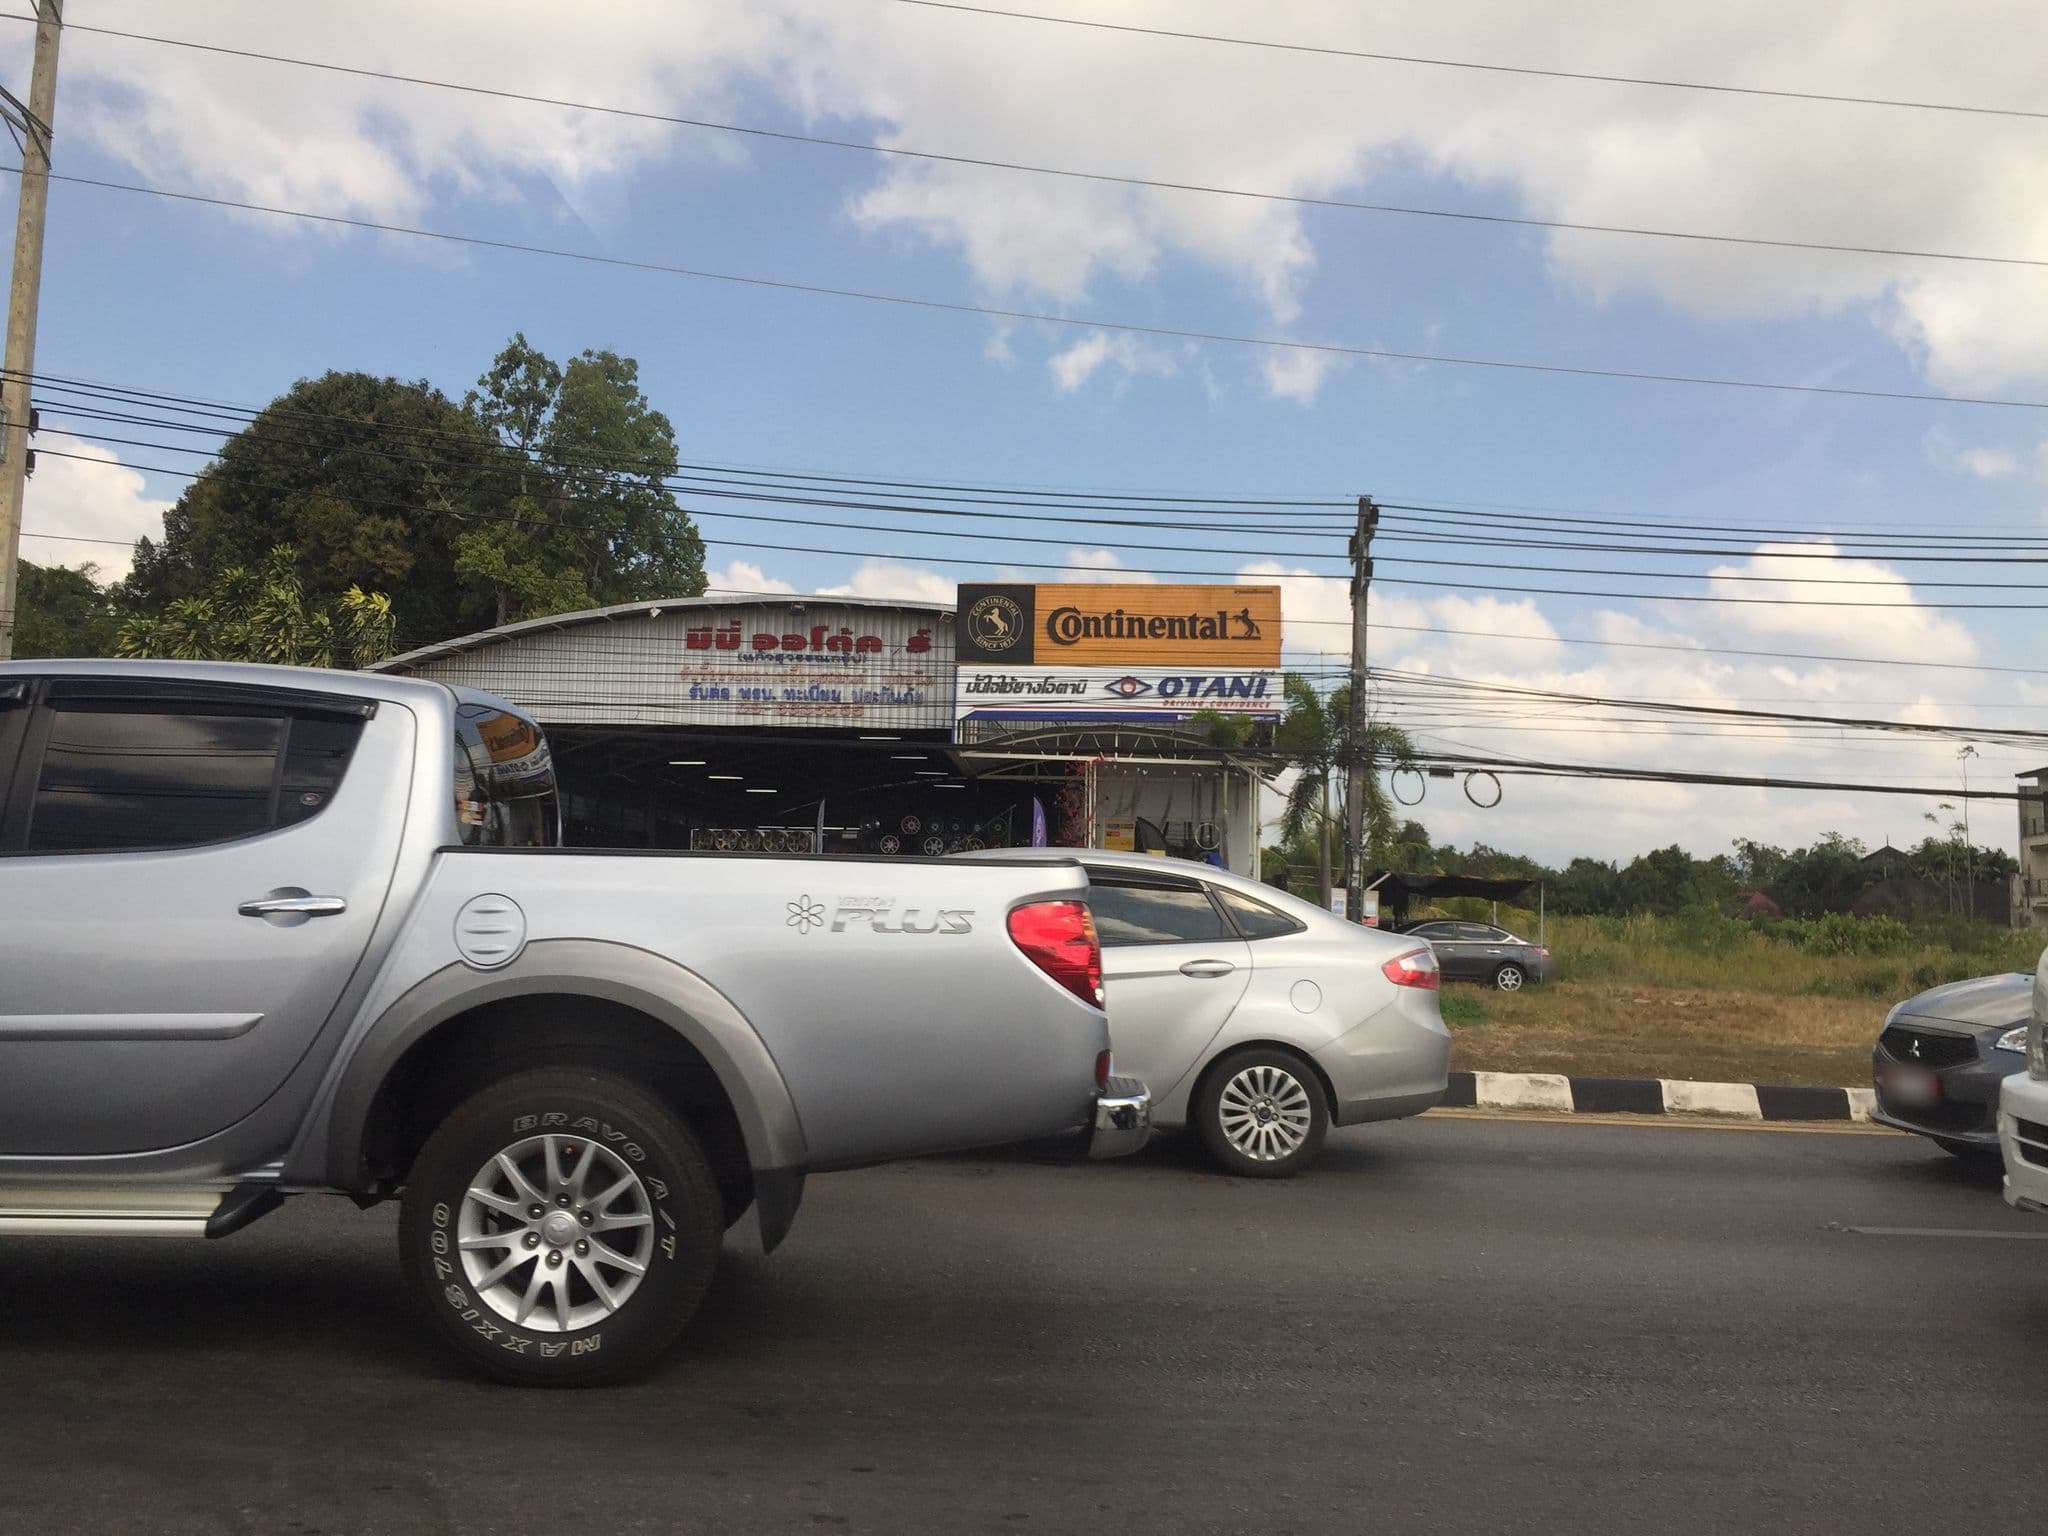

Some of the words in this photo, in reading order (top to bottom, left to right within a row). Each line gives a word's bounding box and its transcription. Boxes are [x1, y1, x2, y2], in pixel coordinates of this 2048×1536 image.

[972, 597, 1019, 617] CONTINENTAL
[1047, 606, 1230, 645] Continental
[976, 635, 996, 649] SINCE
[1157, 676, 1267, 698] OTANI
[1210, 700, 1270, 709] CONFIDENCE
[831, 908, 976, 934] PLUS
[513, 1112, 647, 1163] BRAVO
[445, 1284, 601, 1357] MAXXIS
